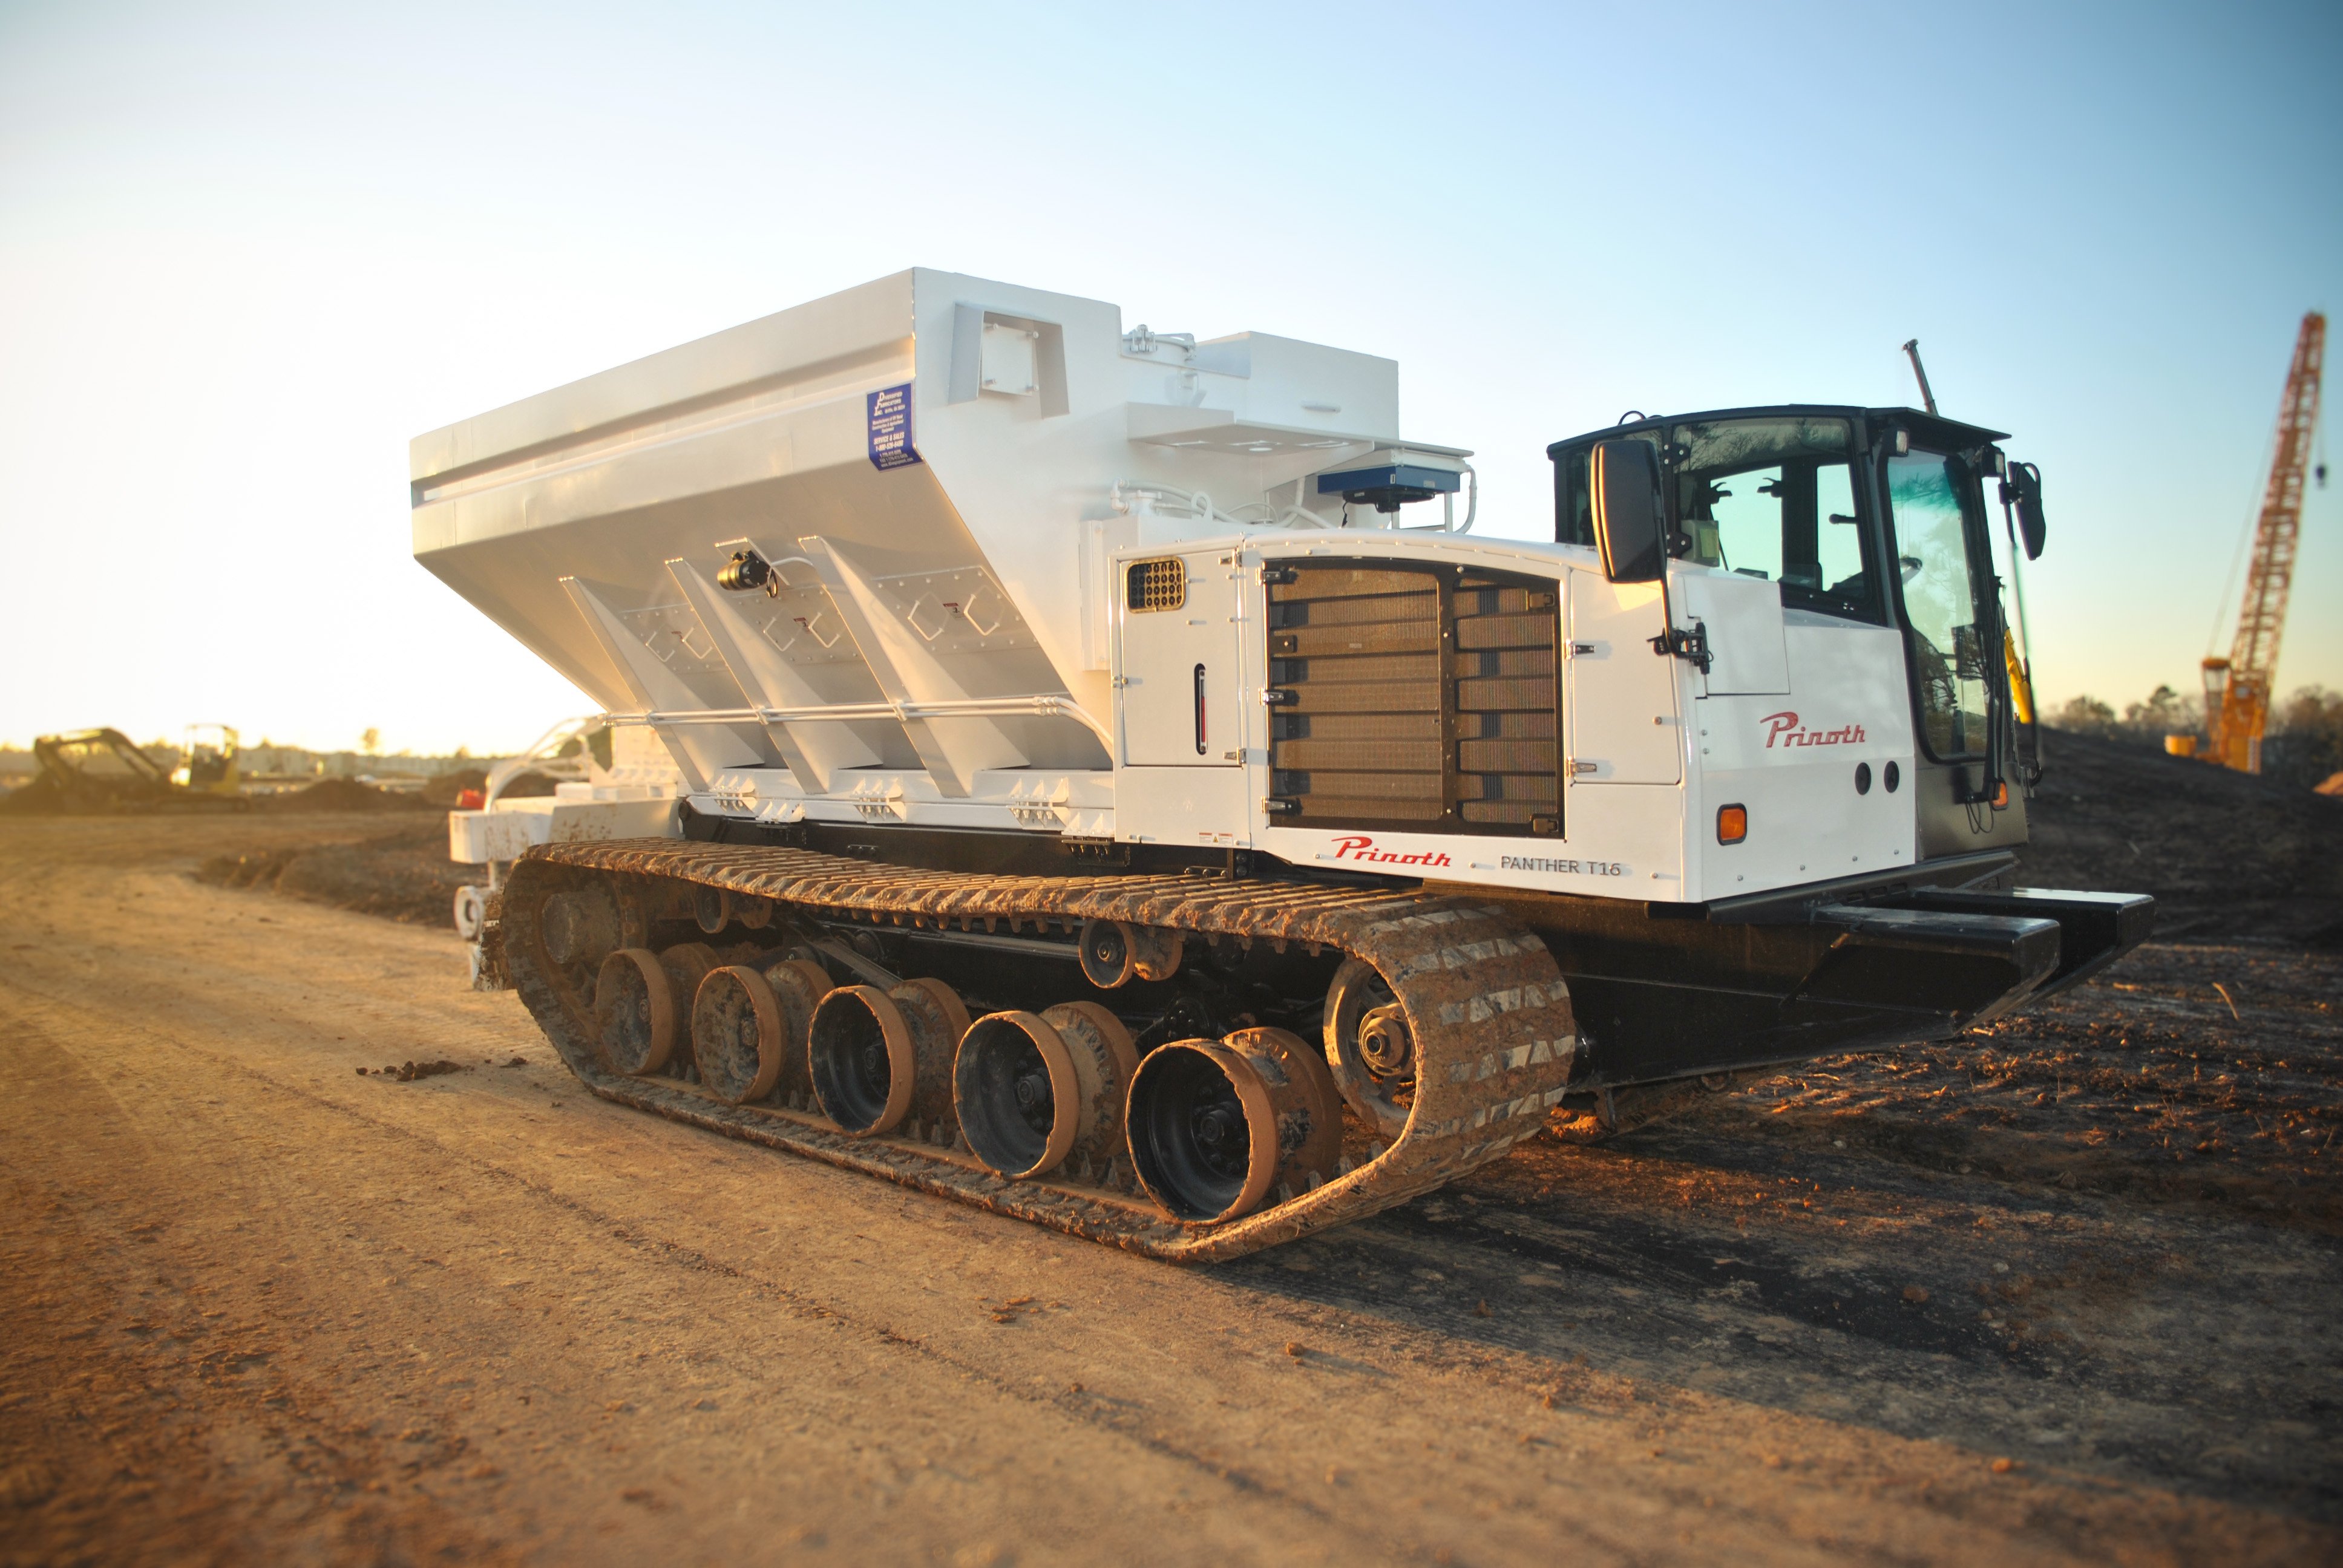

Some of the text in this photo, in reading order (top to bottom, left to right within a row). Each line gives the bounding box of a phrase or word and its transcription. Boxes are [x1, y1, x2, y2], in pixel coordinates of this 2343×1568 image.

[874, 436, 889, 445] SERVICE
[893, 432, 905, 440] SALES
[1760, 711, 1865, 748] Prinoth
[1331, 836, 1450, 867] Prinoth
[1501, 856, 1621, 875] PANTHER T16
